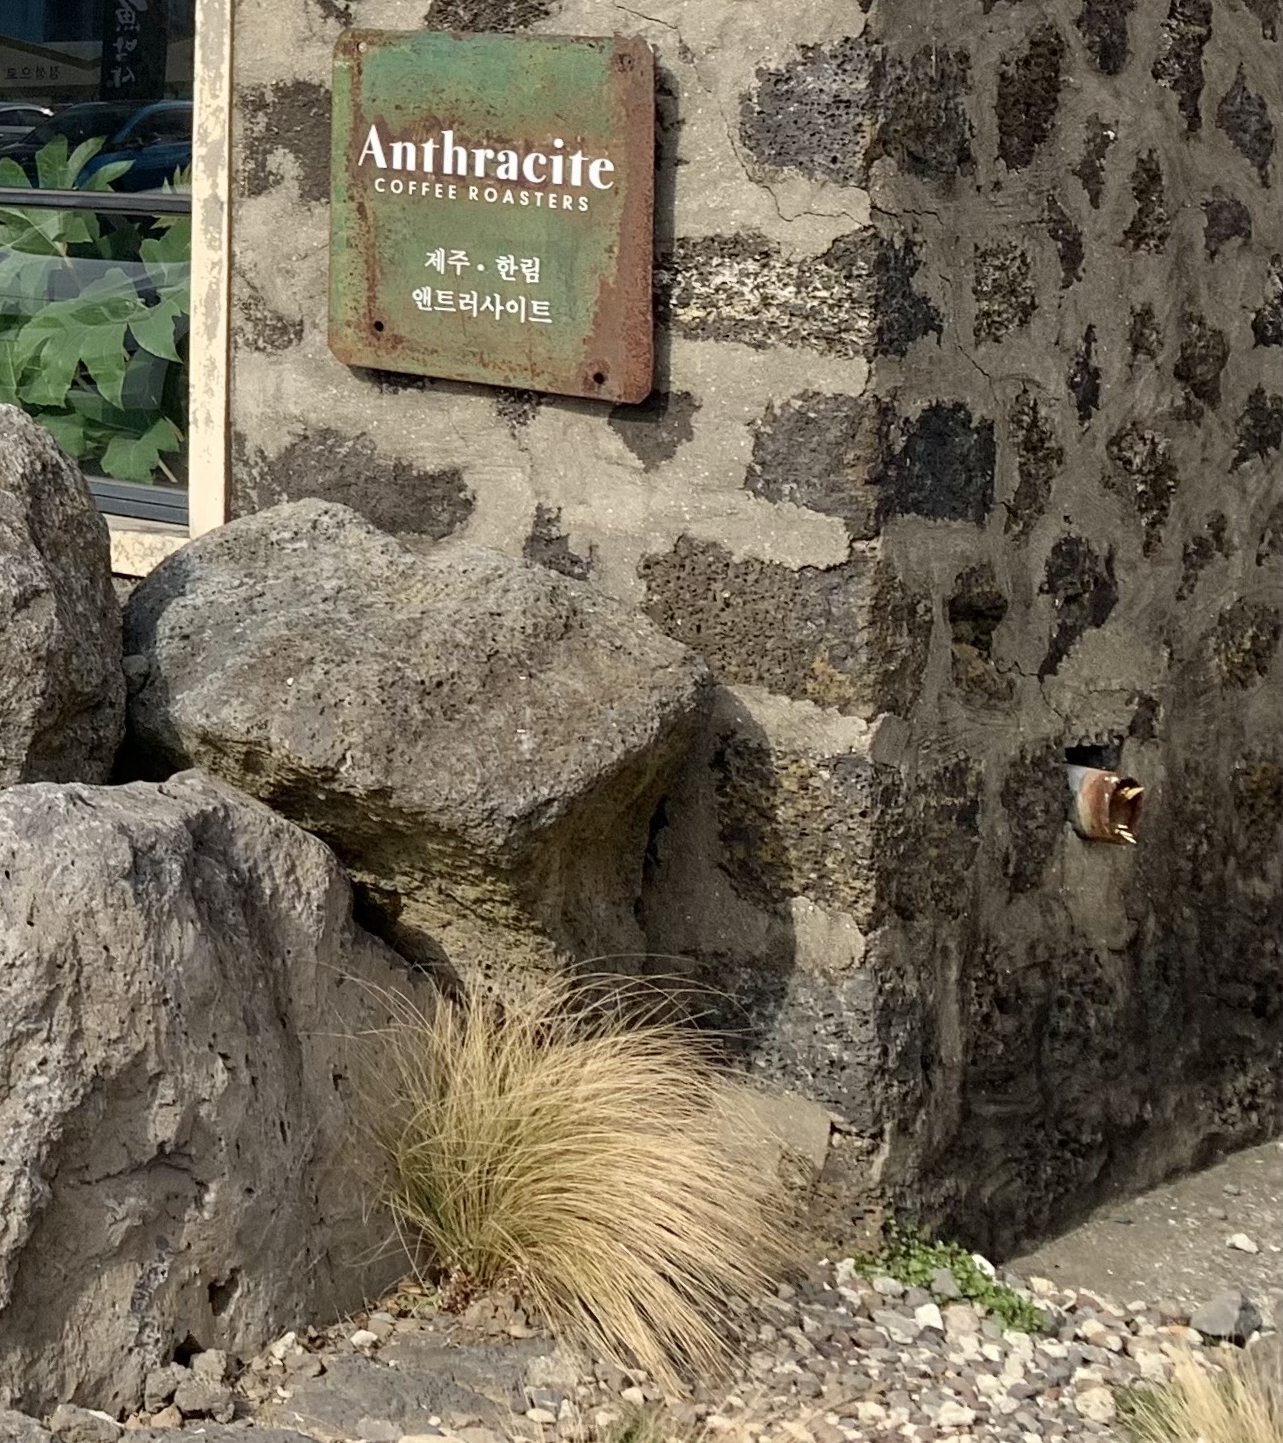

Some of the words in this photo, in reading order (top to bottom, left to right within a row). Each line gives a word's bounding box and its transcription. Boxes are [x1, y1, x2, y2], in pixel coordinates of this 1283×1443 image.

[358, 124, 615, 190] Anthracite
[374, 177, 457, 200] COFFEE
[468, 185, 590, 212] ROASTERS
[411, 285, 553, 324] 앤트러사이트
